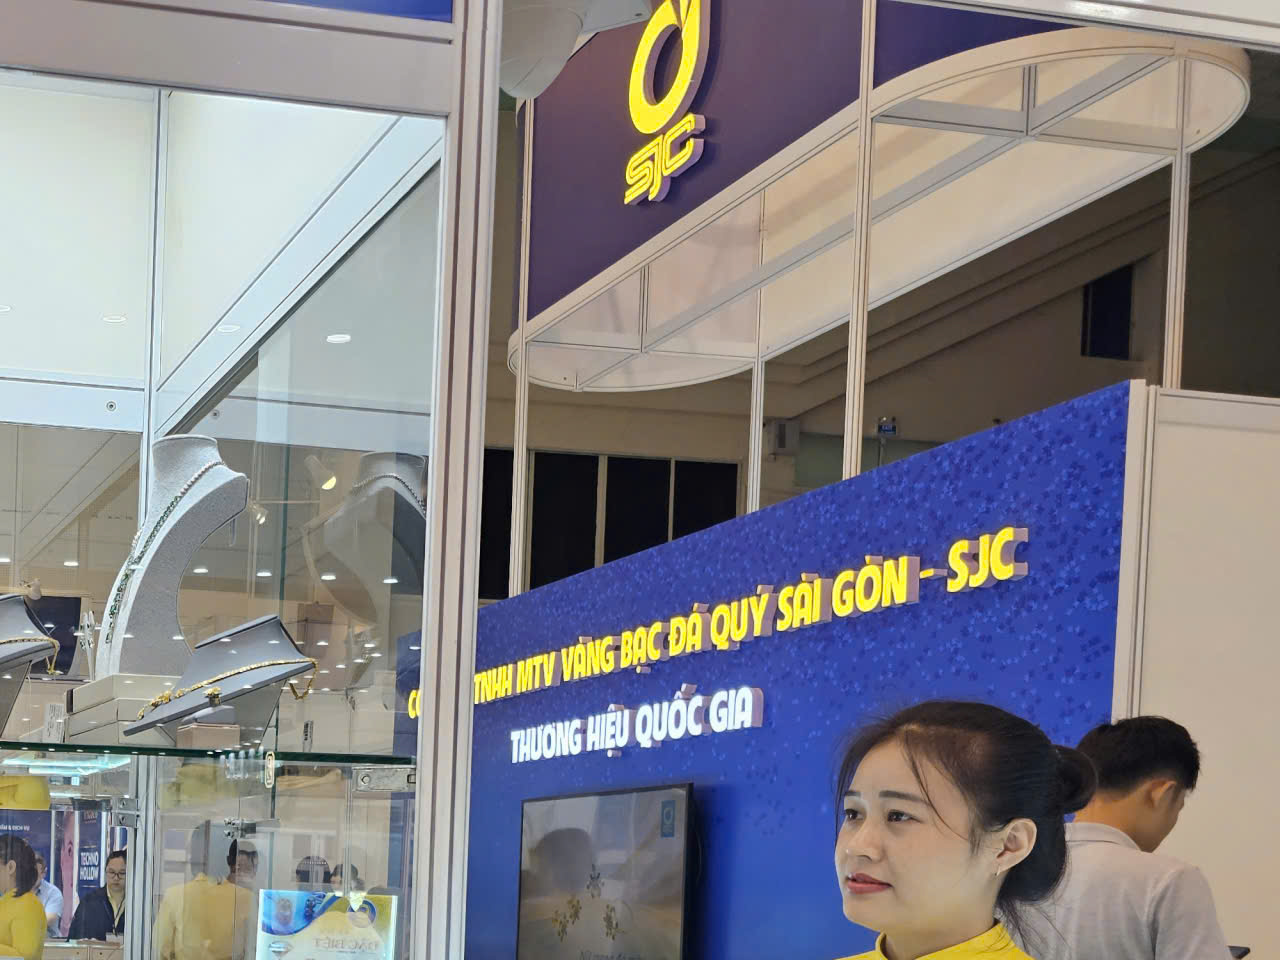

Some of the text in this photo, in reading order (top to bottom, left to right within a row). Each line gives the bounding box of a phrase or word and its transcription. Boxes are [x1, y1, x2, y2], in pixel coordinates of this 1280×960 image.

[624, 113, 702, 205] SJC
[473, 662, 513, 706] TNHH
[516, 651, 557, 695] MTV
[561, 636, 616, 683] VÀNG
[620, 620, 664, 674] BẠC
[667, 603, 706, 658] ĐÁ
[710, 585, 771, 650] QUÝ
[776, 572, 823, 633] SÀI
[831, 555, 912, 619] GÒN
[946, 526, 1022, 593] SJC
[510, 683, 756, 764] THƯƠNG HIỆU QUỐC GIA
[79, 866, 100, 881] HOLLOW
[80, 851, 99, 866] TECHNO
